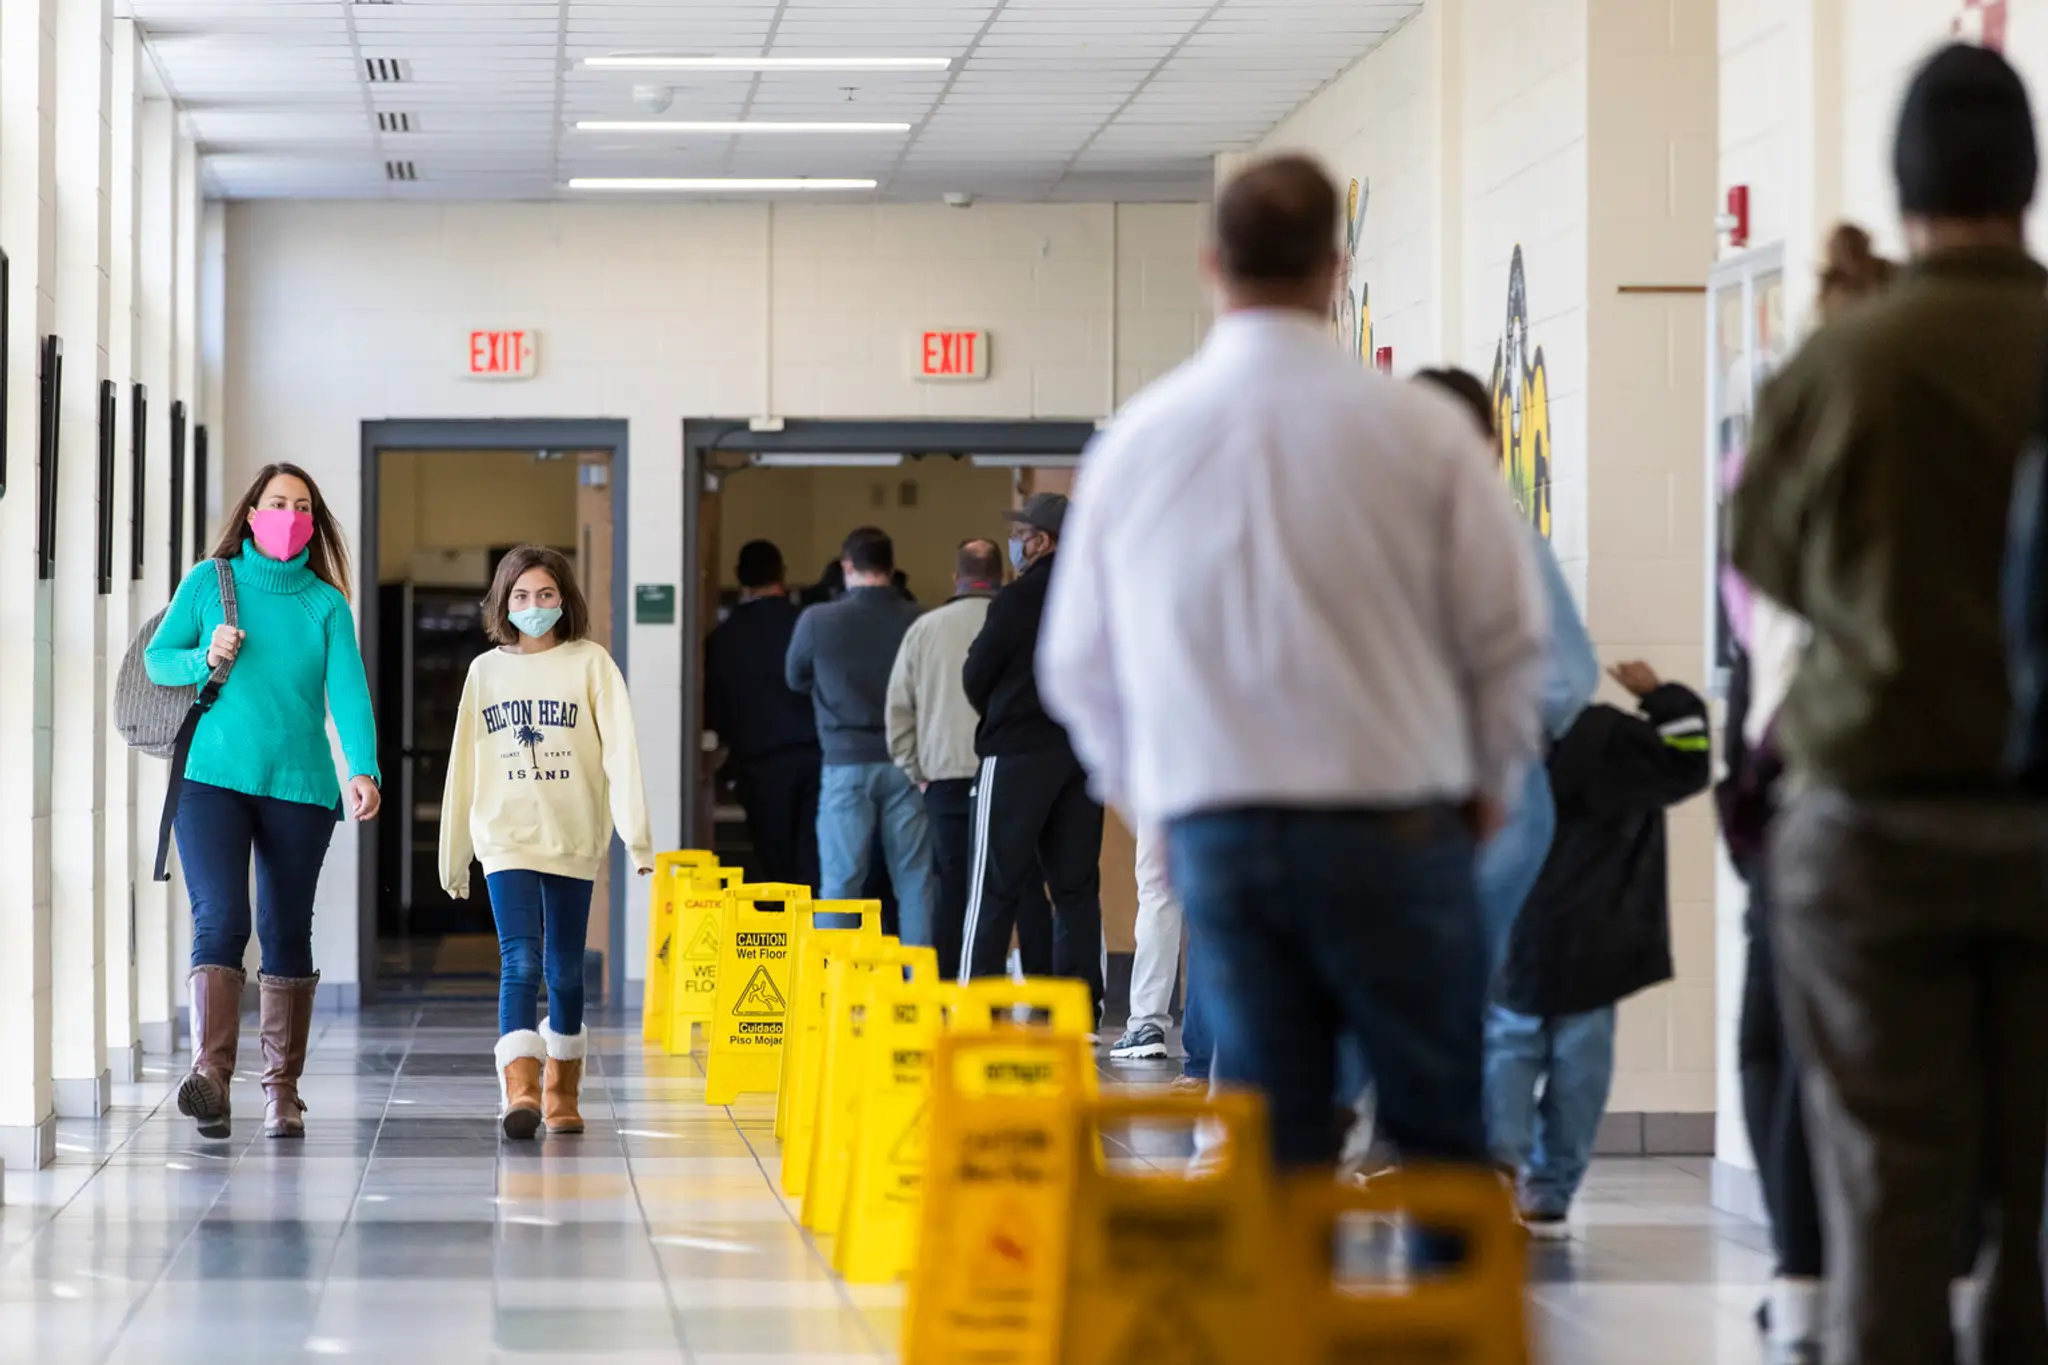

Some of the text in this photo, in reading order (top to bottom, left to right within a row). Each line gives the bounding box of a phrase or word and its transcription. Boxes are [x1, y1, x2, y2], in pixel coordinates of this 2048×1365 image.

[470, 331, 524, 373] EXIT
[923, 332, 977, 374] EXIT
[482, 699, 578, 735] HILTON HEAD
[508, 769, 570, 781] ISAND
[737, 933, 787, 946] CAUTION
[737, 948, 787, 960] Wet Floor
[685, 979, 715, 993] FLO
[740, 1022, 783, 1033] Cuidado
[730, 1036, 752, 1045] Piso
